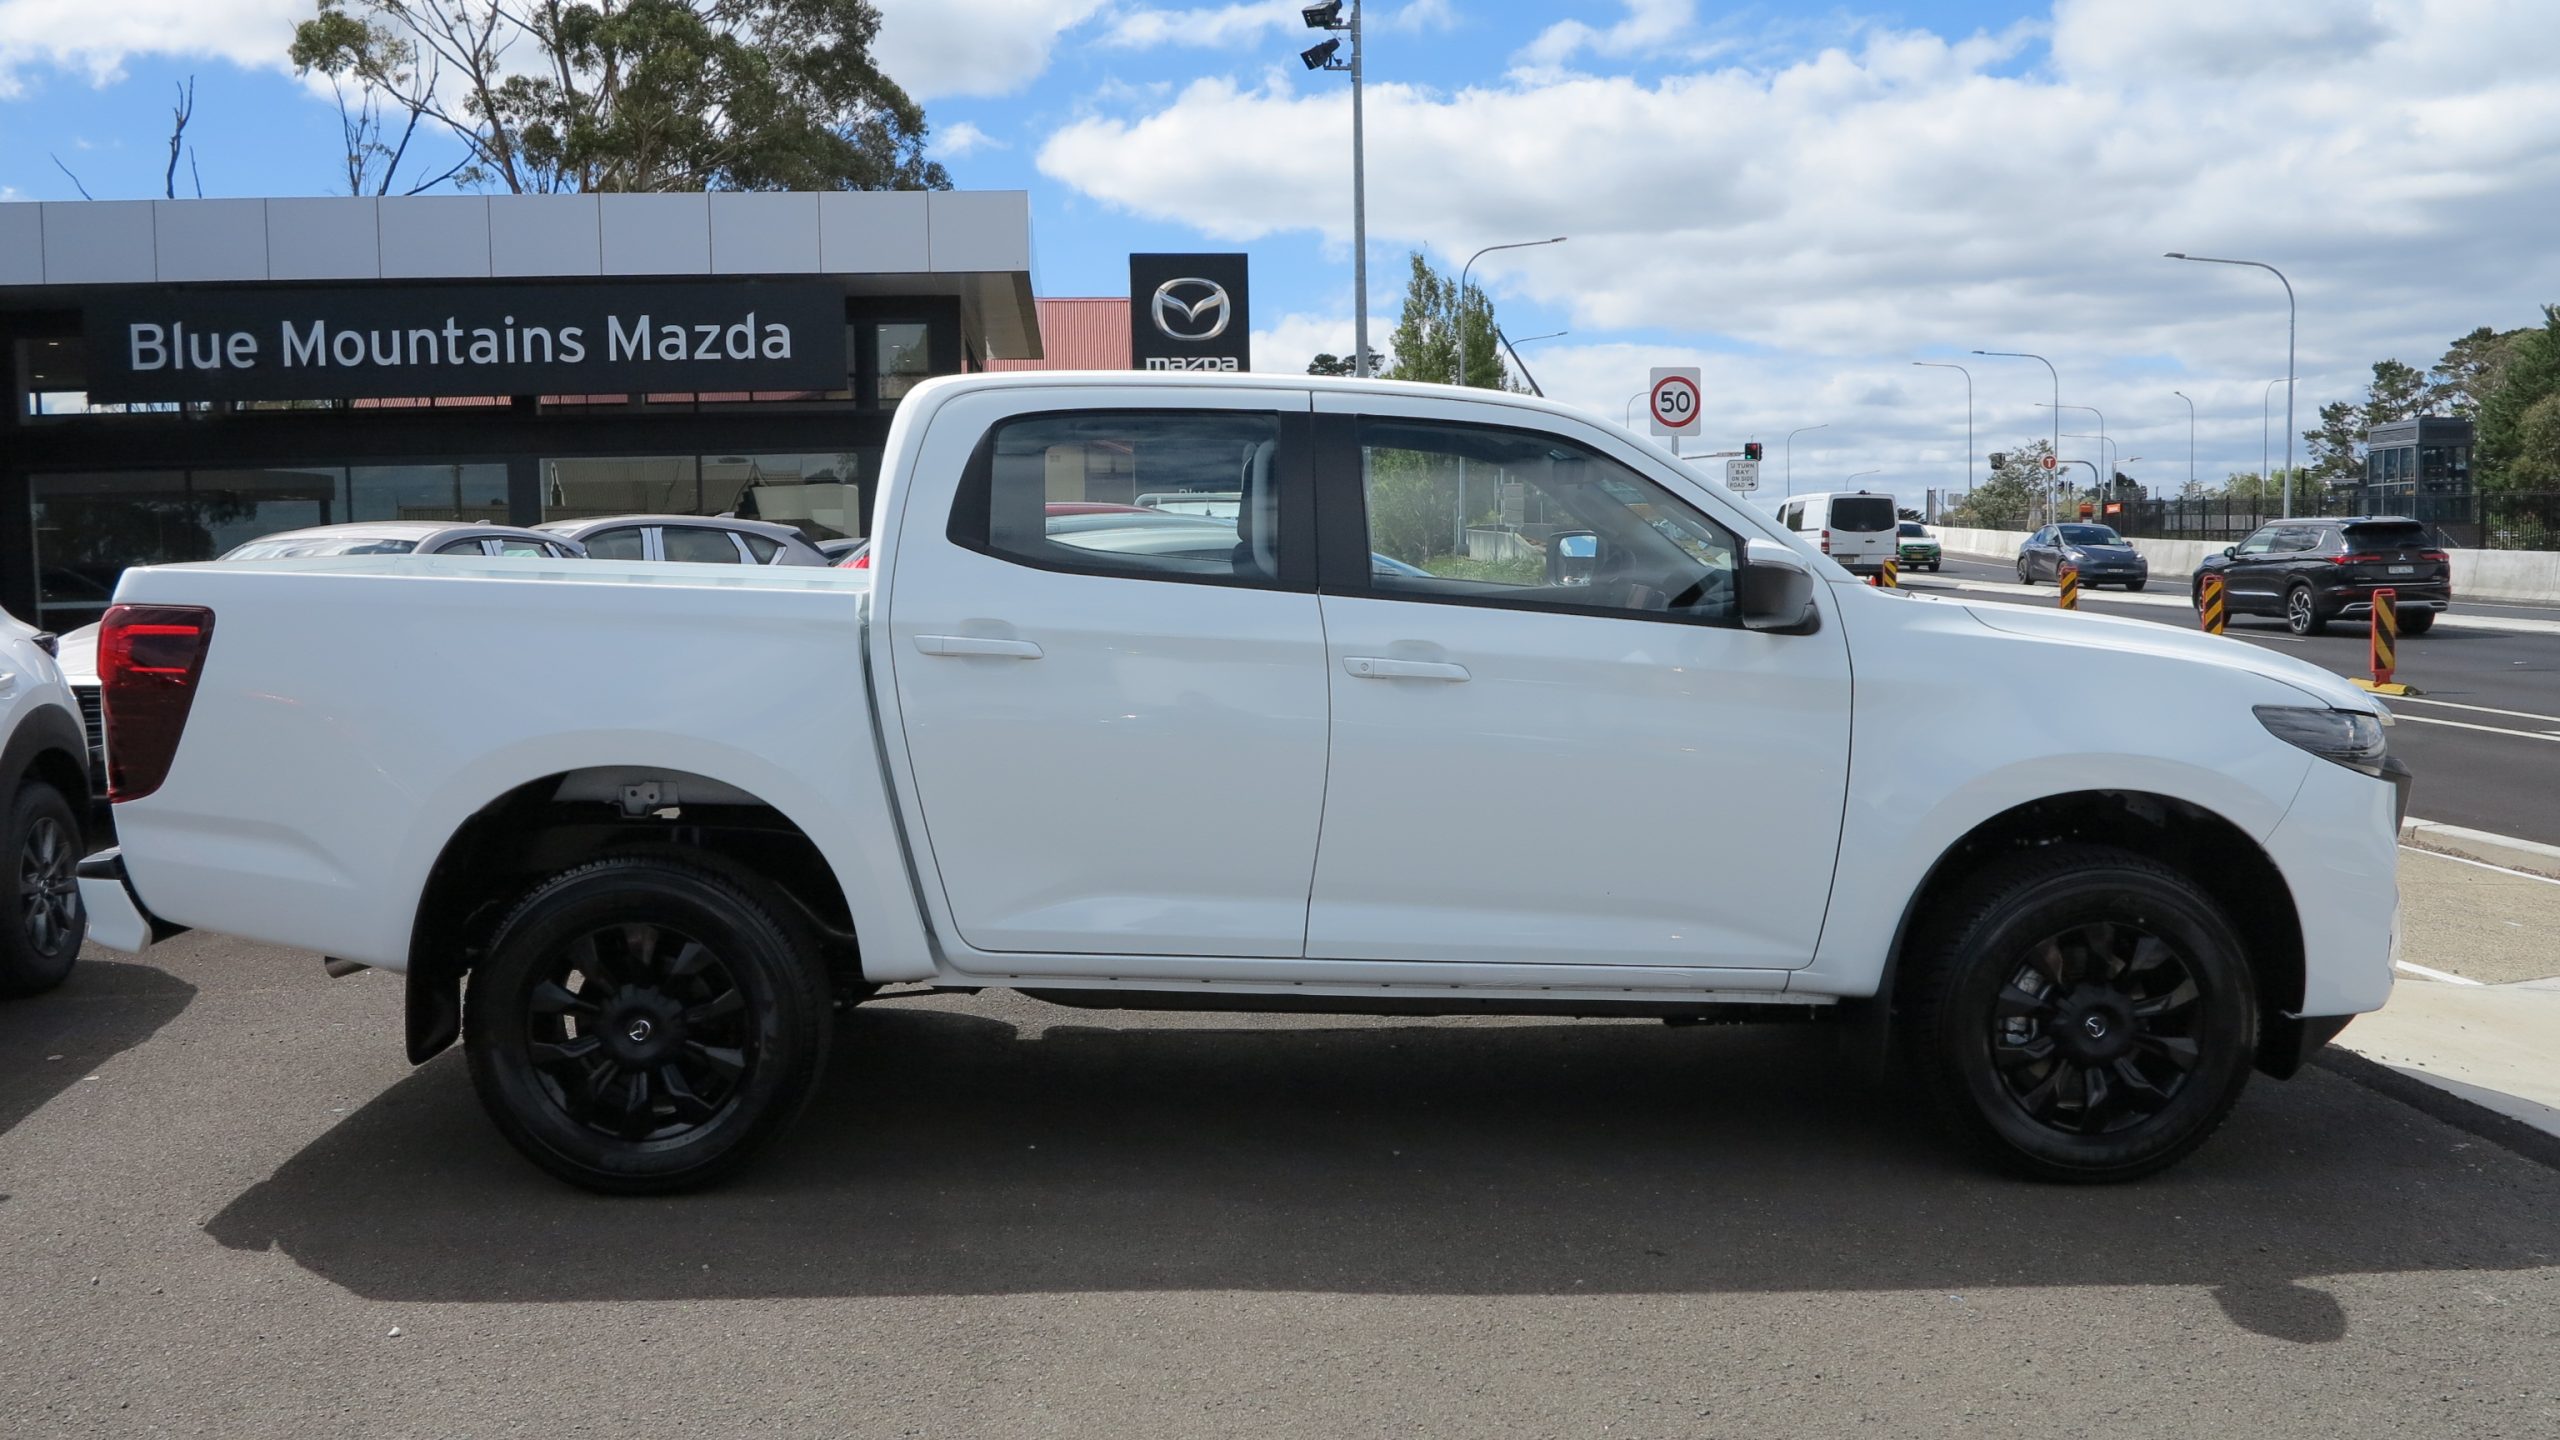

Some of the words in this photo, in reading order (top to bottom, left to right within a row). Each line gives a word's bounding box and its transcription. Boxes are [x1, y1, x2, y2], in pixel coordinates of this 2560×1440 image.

[130, 321, 258, 370] Blue
[282, 316, 586, 366] Mountains
[607, 311, 792, 361] Mazda
[1661, 391, 1690, 413] 50
